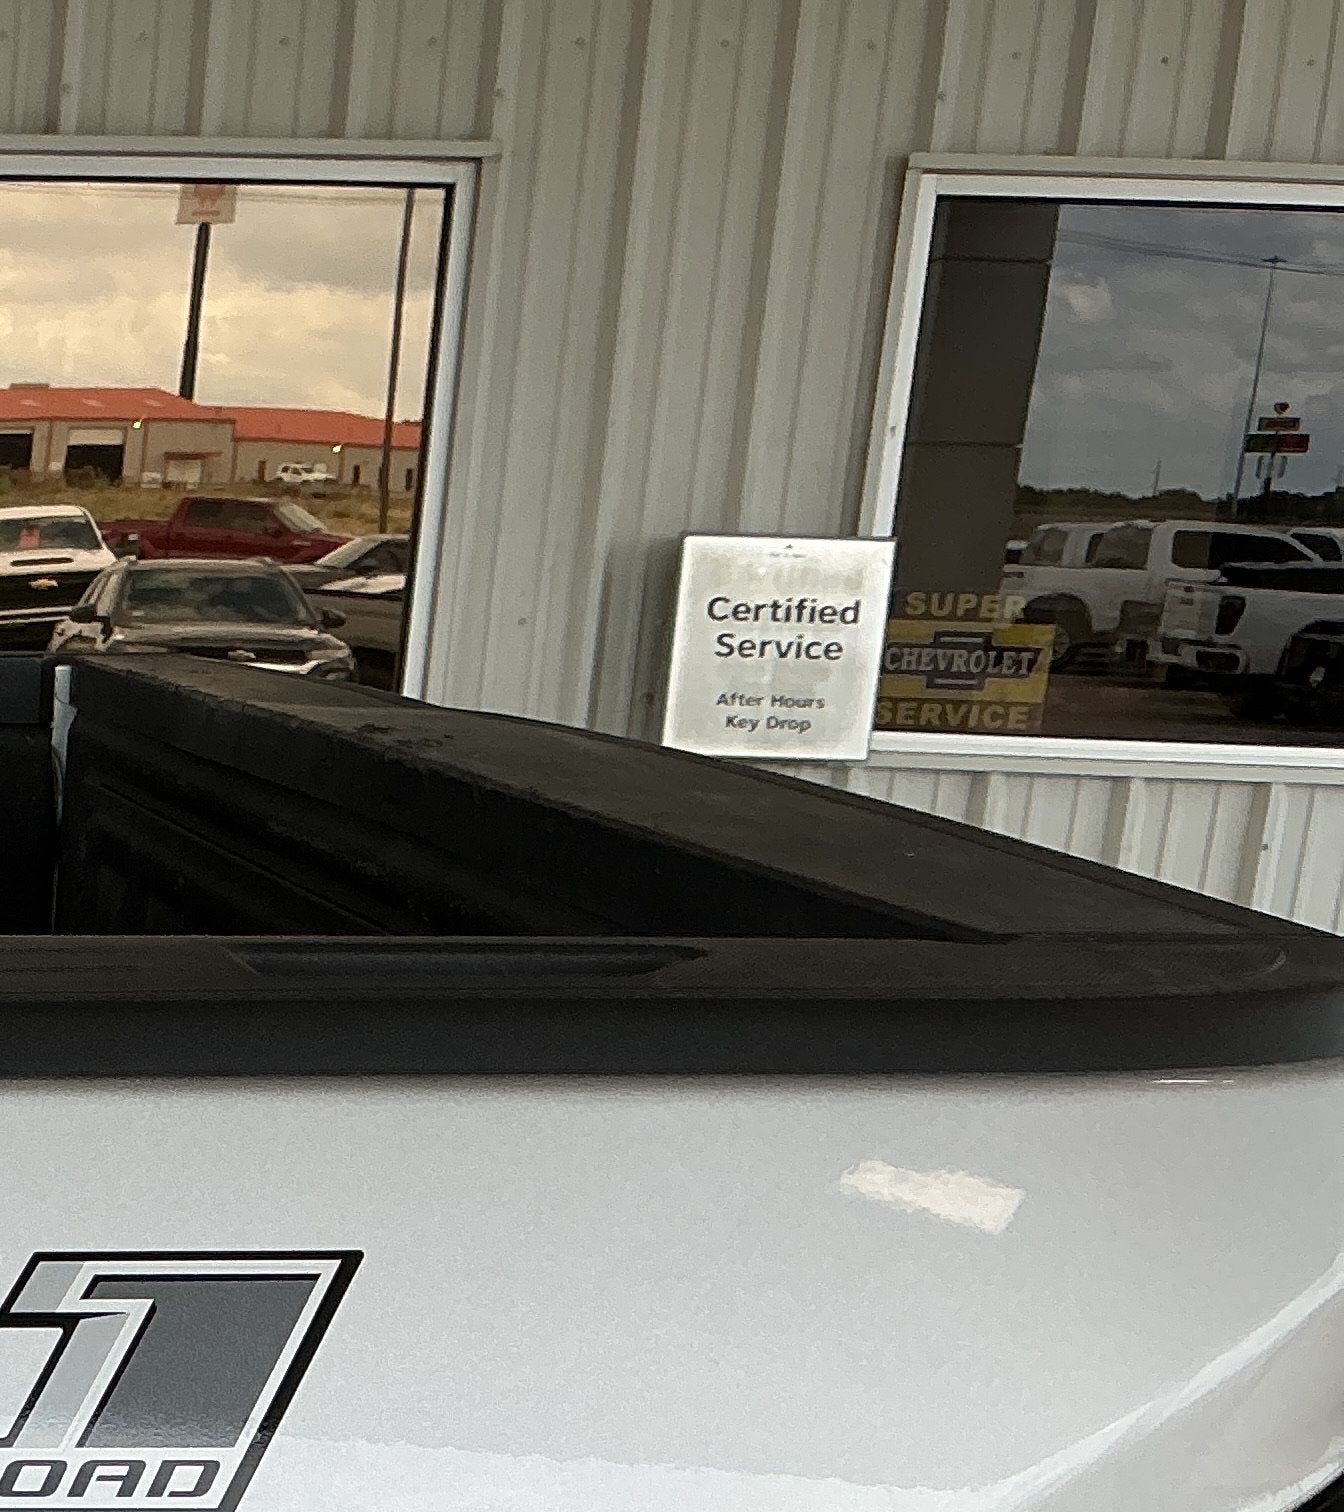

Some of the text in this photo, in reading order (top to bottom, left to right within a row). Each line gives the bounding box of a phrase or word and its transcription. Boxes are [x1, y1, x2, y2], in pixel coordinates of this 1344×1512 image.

[707, 597, 861, 625] Certified
[905, 591, 1027, 619] SUPER
[714, 633, 844, 661] Service
[885, 647, 1035, 675] CHEVROLET
[716, 692, 826, 709] After Hours
[725, 715, 812, 735] Key Drop
[877, 701, 1031, 730] SERVICE
